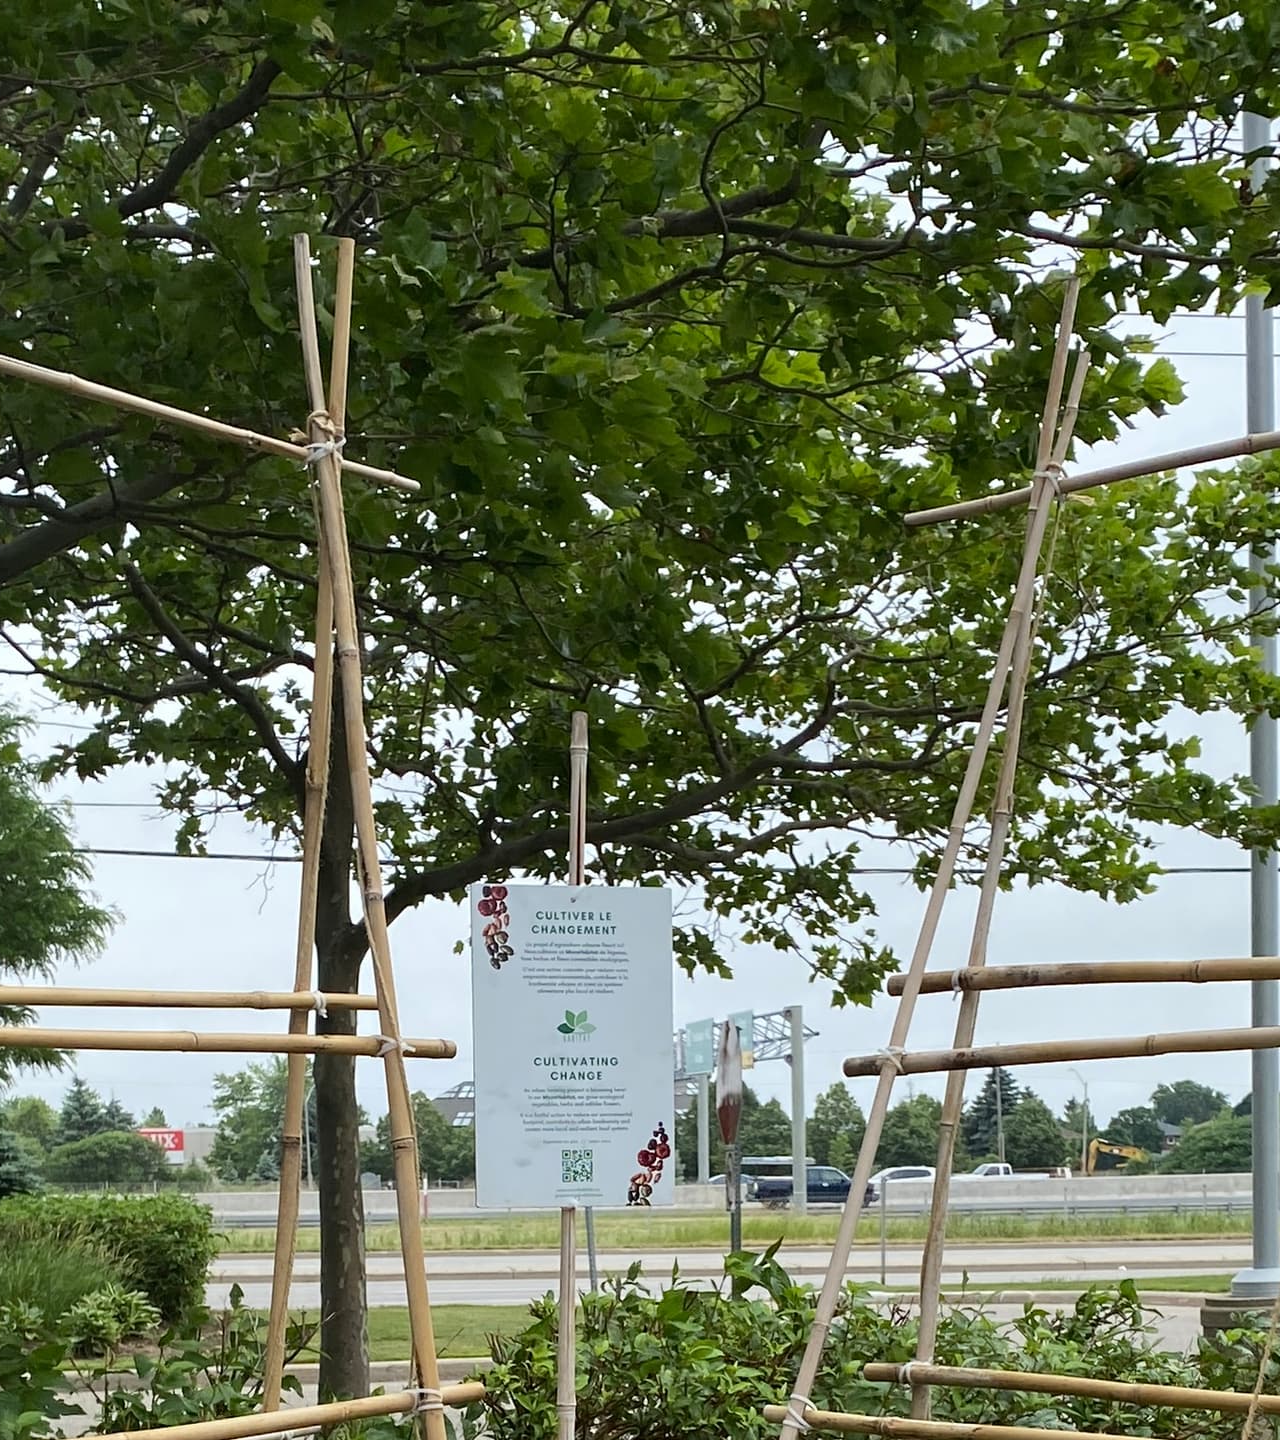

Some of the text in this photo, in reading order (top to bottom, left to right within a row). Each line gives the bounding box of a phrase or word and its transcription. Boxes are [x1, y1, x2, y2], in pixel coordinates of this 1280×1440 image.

[535, 911, 612, 921] CULTIVER LE
[531, 924, 617, 935] CHANGEMENT
[533, 1056, 619, 1067] CULTIVATING
[550, 1071, 603, 1081] CHANGE
